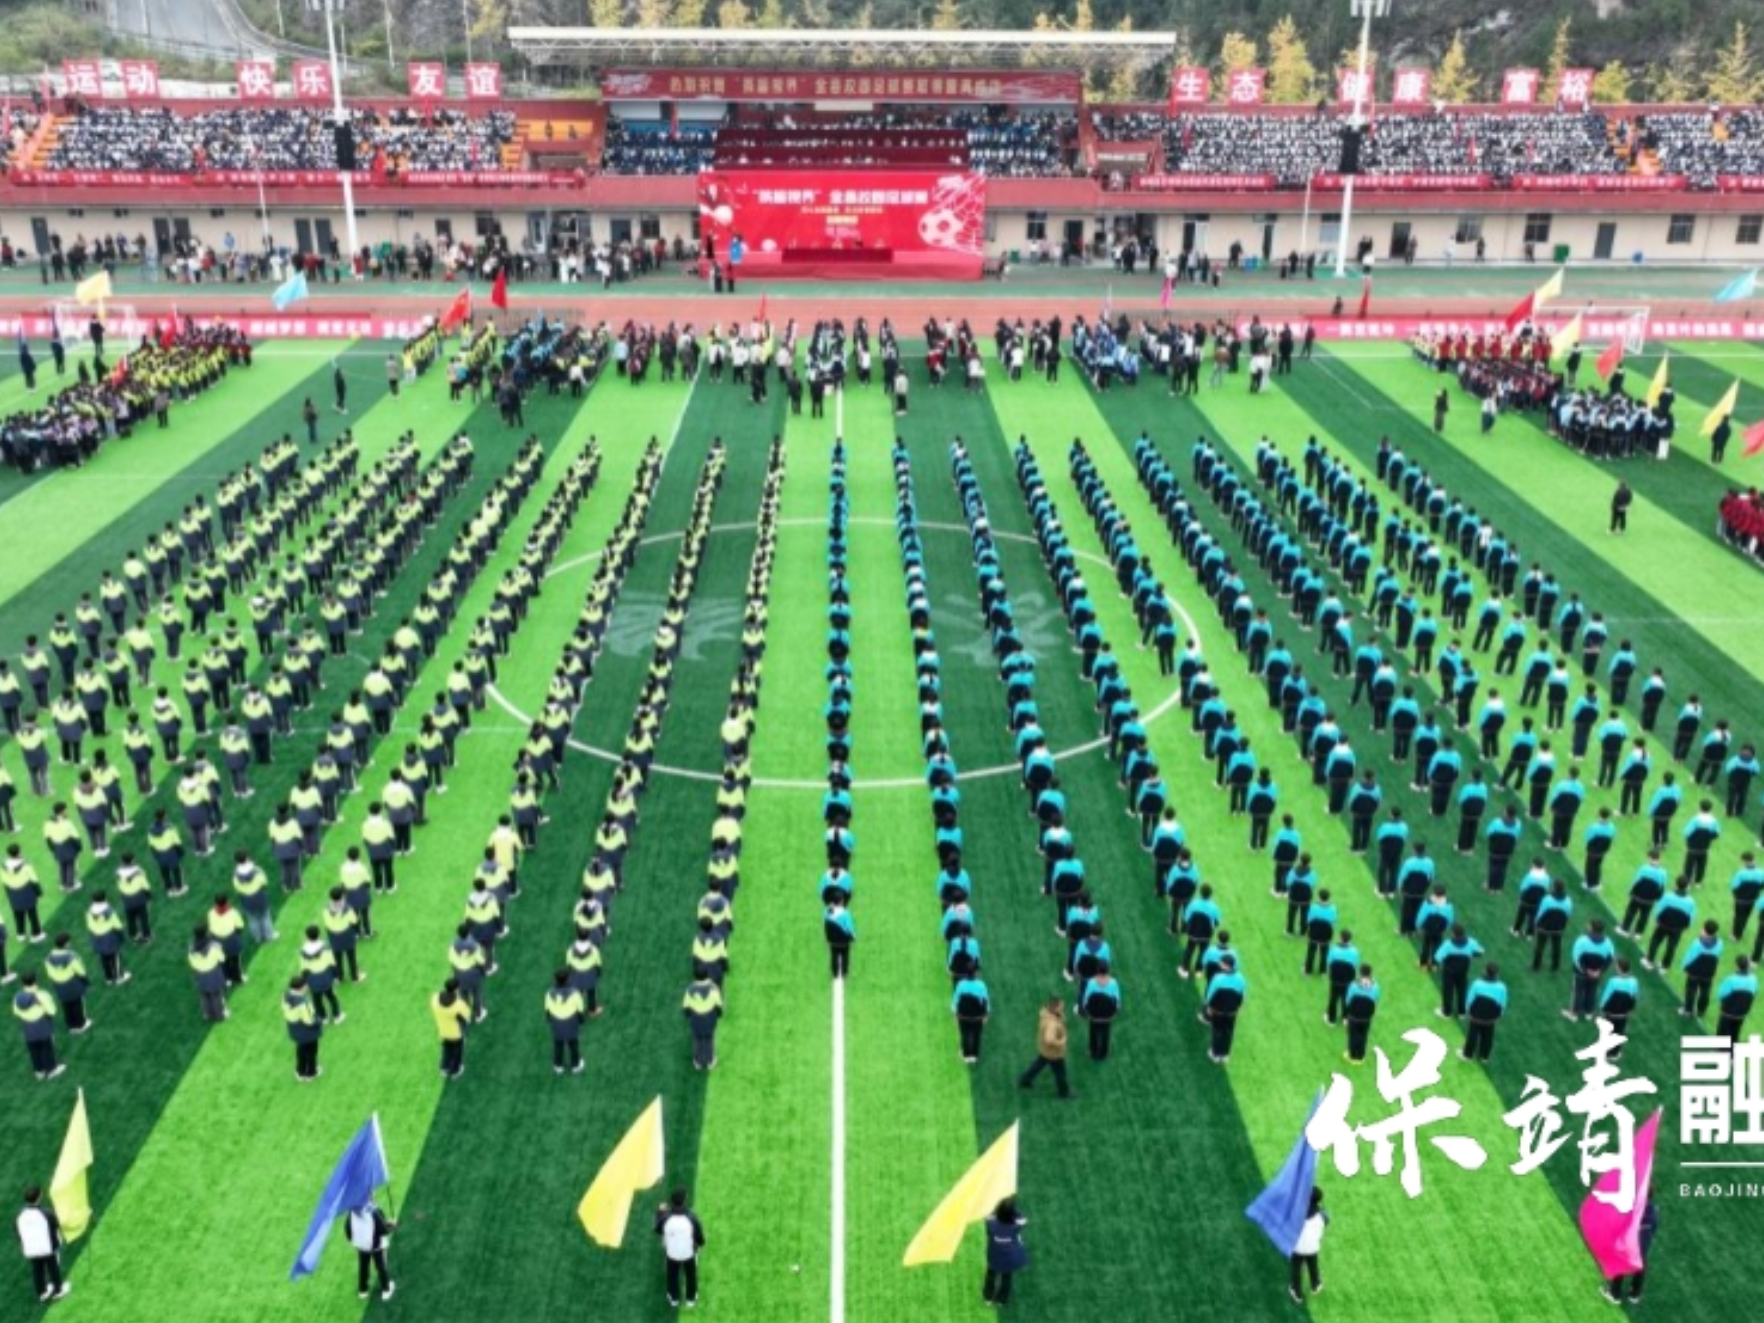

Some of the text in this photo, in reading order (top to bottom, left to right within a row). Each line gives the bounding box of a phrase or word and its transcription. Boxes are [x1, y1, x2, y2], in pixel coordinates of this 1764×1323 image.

[63, 64, 500, 97] 运动 快乐 友谊
[1176, 72, 1260, 101] 生态
[1505, 71, 1592, 102] 富裕
